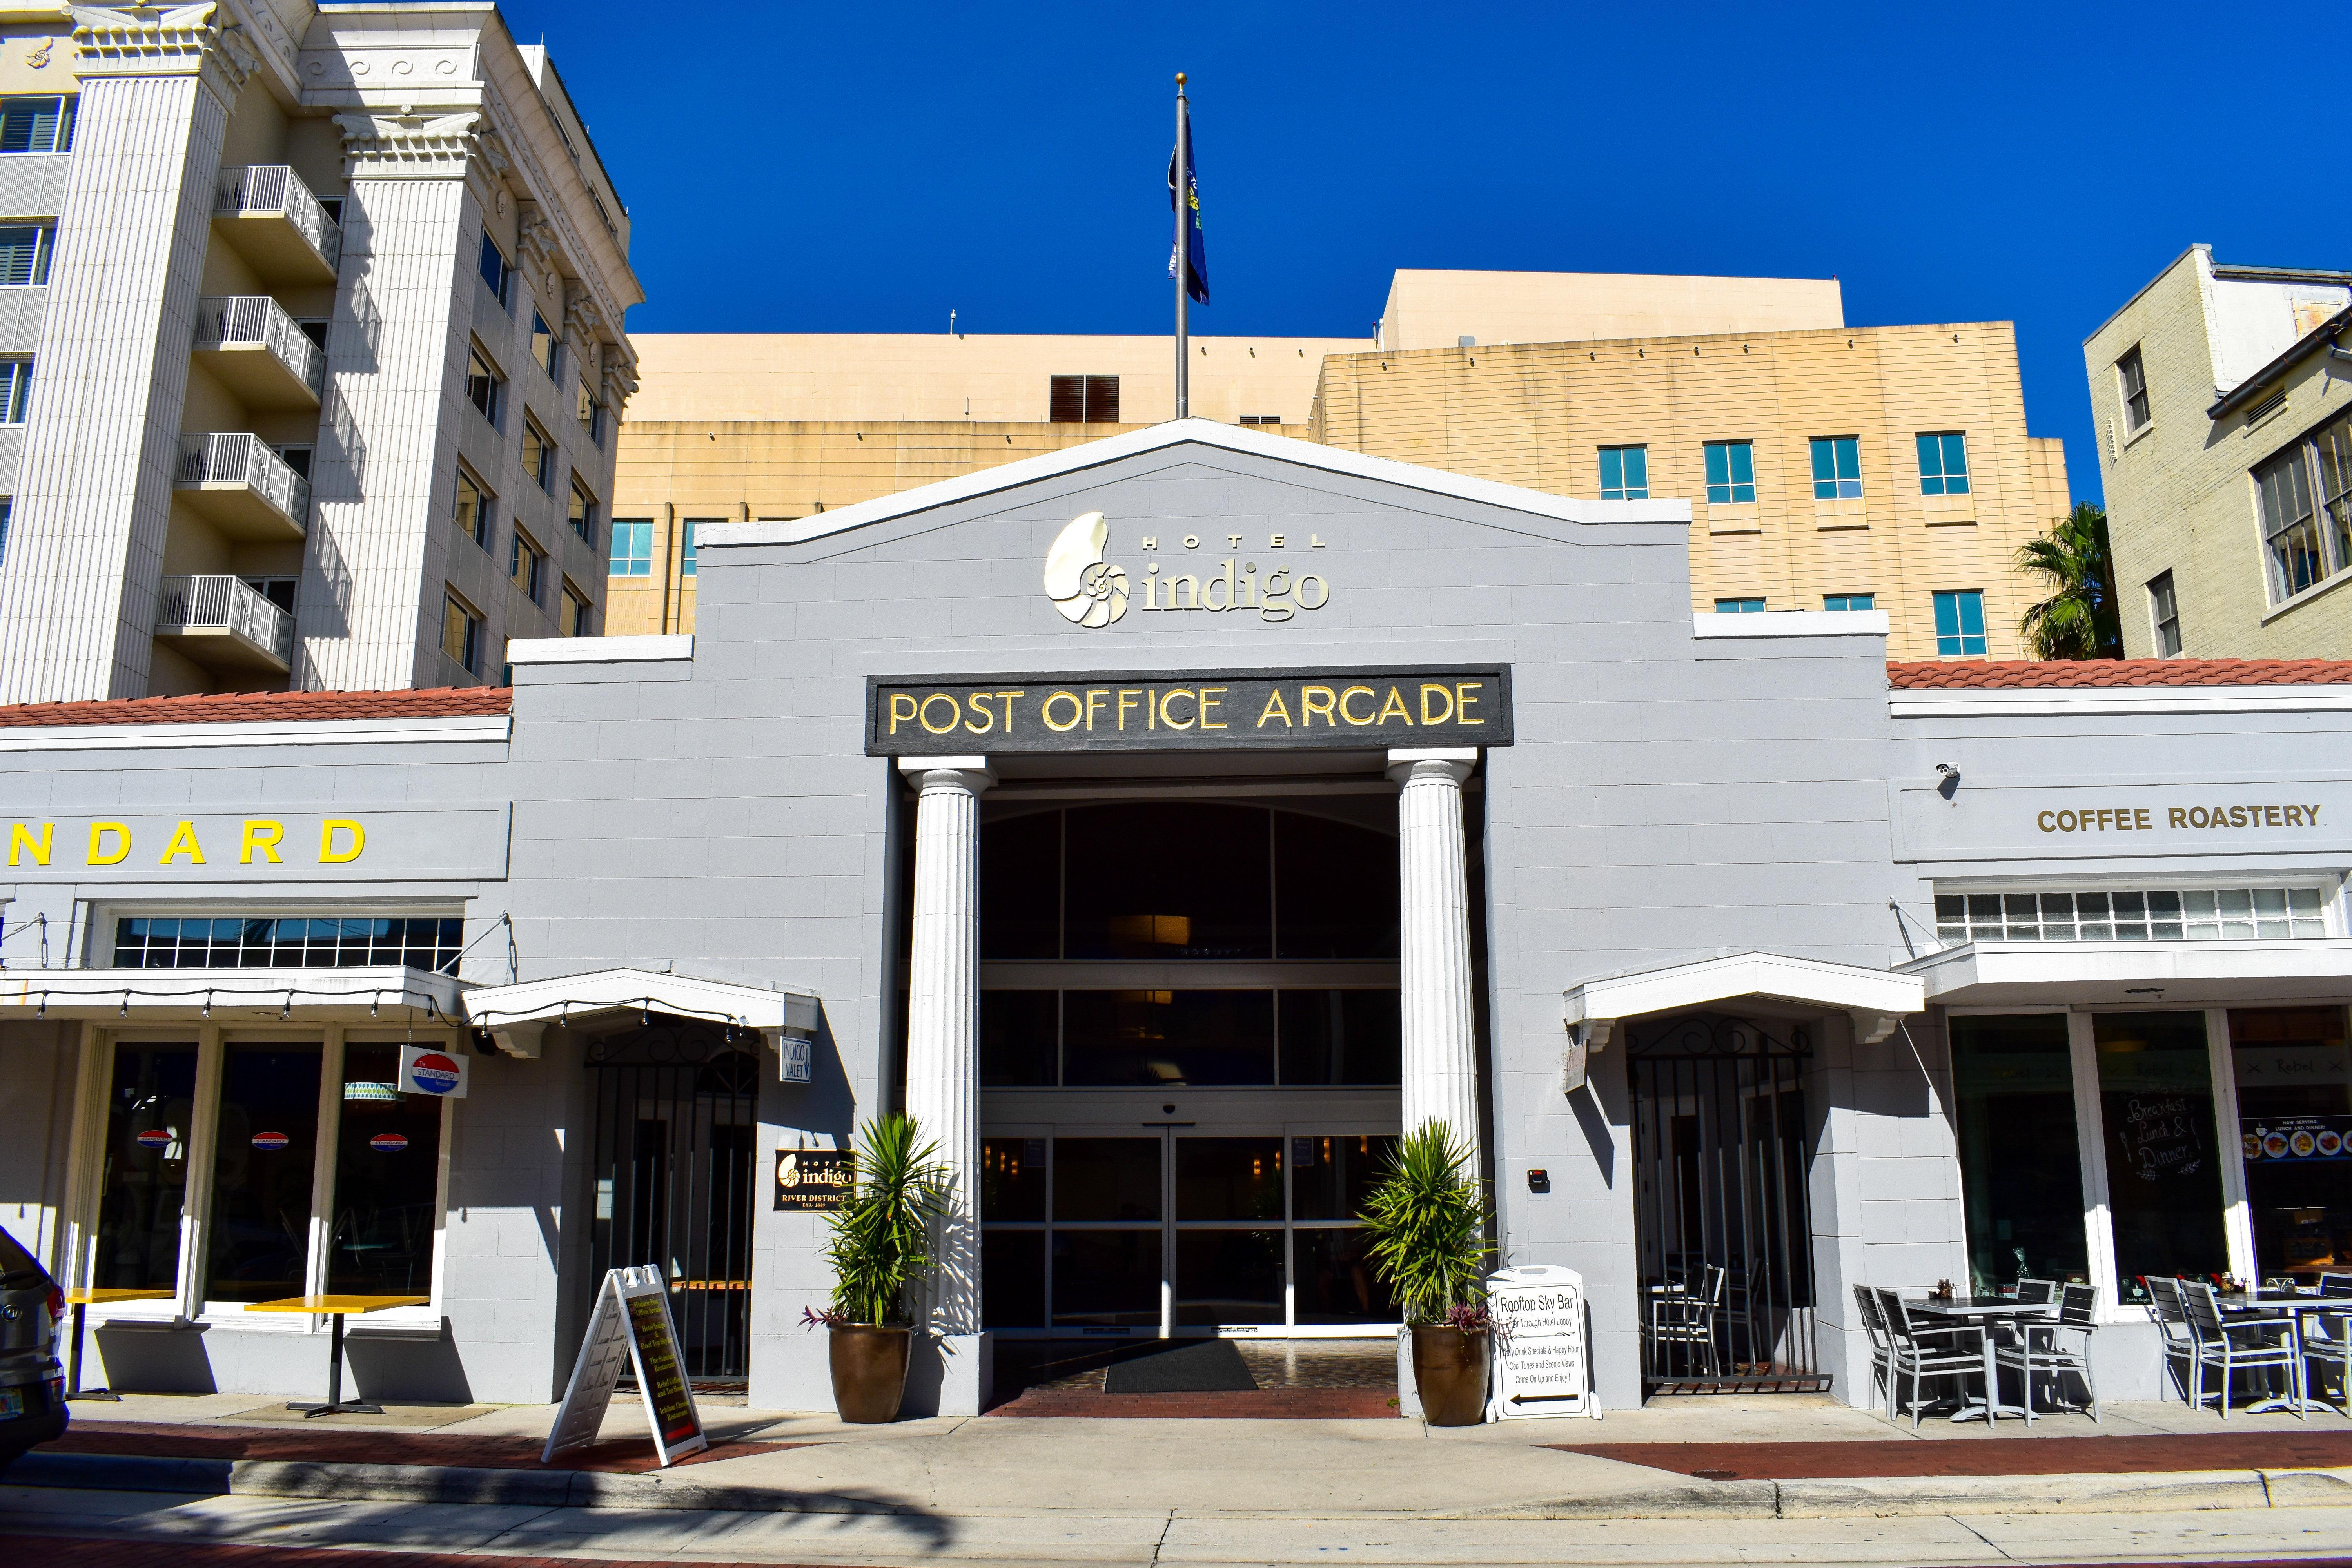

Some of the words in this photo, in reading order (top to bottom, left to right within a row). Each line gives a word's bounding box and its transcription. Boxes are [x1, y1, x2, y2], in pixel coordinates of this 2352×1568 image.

[1142, 534, 1326, 550] HOTEL
[1141, 558, 1330, 622] indigo
[889, 691, 1024, 735] POST
[1042, 687, 1228, 732] OFFICE
[1256, 682, 1485, 728] ARCADE
[2038, 808, 2152, 833] COFFEE
[2168, 804, 2320, 829] ROASTERY
[784, 1043, 805, 1061] INDIGO
[418, 1069, 454, 1080] STANDARD
[786, 1063, 803, 1078] VALET
[2275, 1059, 2315, 1074] Rebel
[2127, 1098, 2187, 1122] Breakfast
[2138, 1120, 2170, 1143] Lunch
[2174, 1116, 2187, 1136] &
[2139, 1145, 2188, 1169] Dinner
[802, 1168, 852, 1187] indigo
[1501, 1296, 1535, 1315] Rooftop
[1538, 1294, 1555, 1314] Sky
[1557, 1294, 1573, 1309] Bar
[1520, 1318, 1541, 1328] Through
[1542, 1316, 1555, 1327] Hotel
[1556, 1316, 1572, 1327] Lobby
[640, 1340, 652, 1350] Roof
[1515, 1347, 1527, 1356] Drink
[1528, 1346, 1547, 1357] Specials
[1548, 1346, 1551, 1354] &
[1552, 1345, 1567, 1355] Happy
[1568, 1345, 1579, 1353] Hour
[1510, 1361, 1520, 1370] Cool
[1521, 1361, 1535, 1370] Tunes
[1535, 1360, 1544, 1368] and
[1545, 1359, 1560, 1368] Scenic
[1561, 1359, 1575, 1367] Views
[1515, 1375, 1528, 1384] Come
[1538, 1374, 1544, 1384] Up
[1545, 1374, 1553, 1382] and
[1555, 1373, 1570, 1383] Enjoy!!
